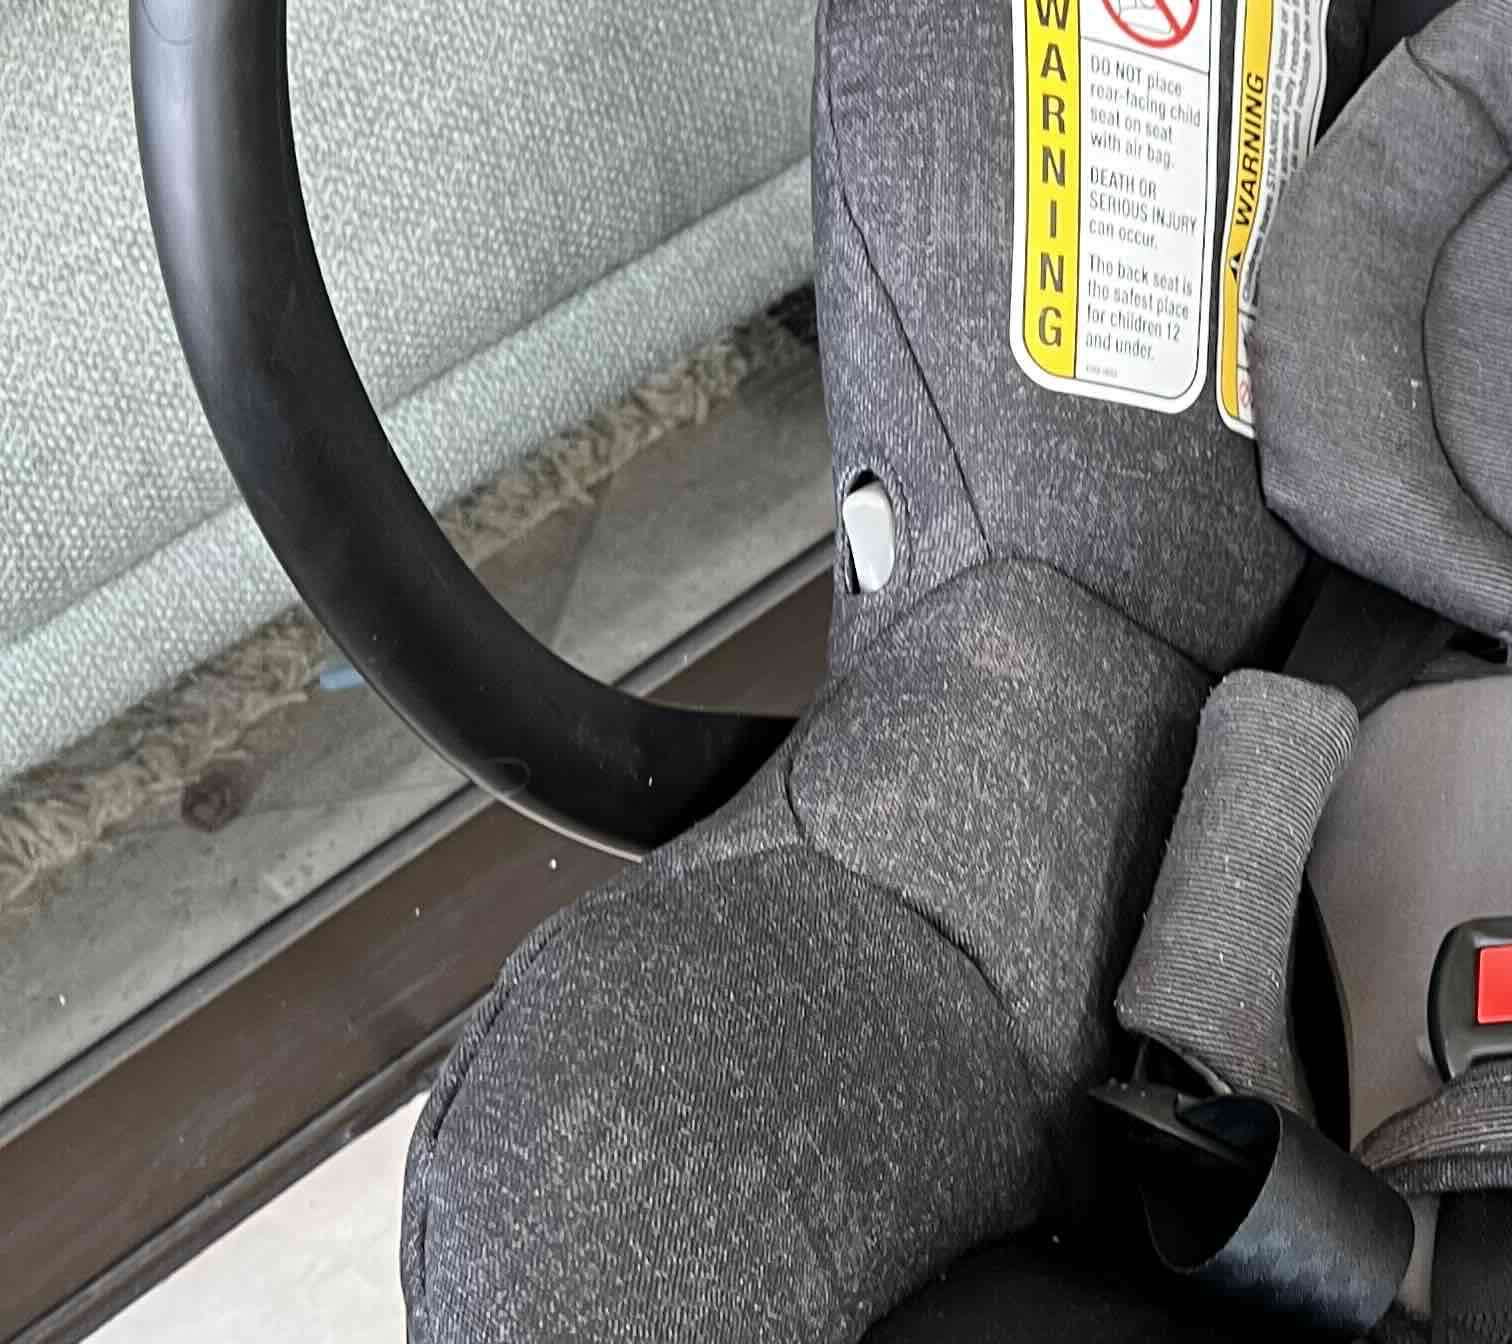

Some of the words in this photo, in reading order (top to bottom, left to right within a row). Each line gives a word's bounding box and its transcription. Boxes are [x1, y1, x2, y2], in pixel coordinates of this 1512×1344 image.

[1090, 55, 1111, 77] DO
[1116, 60, 1143, 85] NOT
[1147, 71, 1182, 96] place
[1090, 83, 1167, 121] rear-facing
[1170, 103, 1201, 128] child
[1090, 106, 1120, 129] seat
[1125, 116, 1141, 134] on
[1145, 121, 1173, 143] seat
[1090, 131, 1121, 153] with
[1126, 138, 1142, 160] air
[1147, 143, 1175, 170] bag.
[1235, 72, 1264, 227] WARNING
[1090, 165, 1135, 194] DEATH
[1139, 176, 1157, 201] OR
[1089, 190, 1148, 223] SERIOUS
[1152, 205, 1199, 234] INJURY
[1089, 218, 1114, 239] can
[1119, 226, 1158, 249] occur.
[1088, 252, 1113, 276] The
[1118, 258, 1149, 285] back
[1153, 272, 1179, 294] seat
[1182, 276, 1193, 297] is
[1088, 279, 1109, 301] the
[1113, 287, 1153, 311] safest
[1156, 296, 1189, 320] place
[1087, 303, 1105, 324] for
[1110, 311, 1162, 338] children
[1167, 320, 1180, 343] 12
[1086, 332, 1111, 352] and
[1115, 337, 1155, 361] under.
